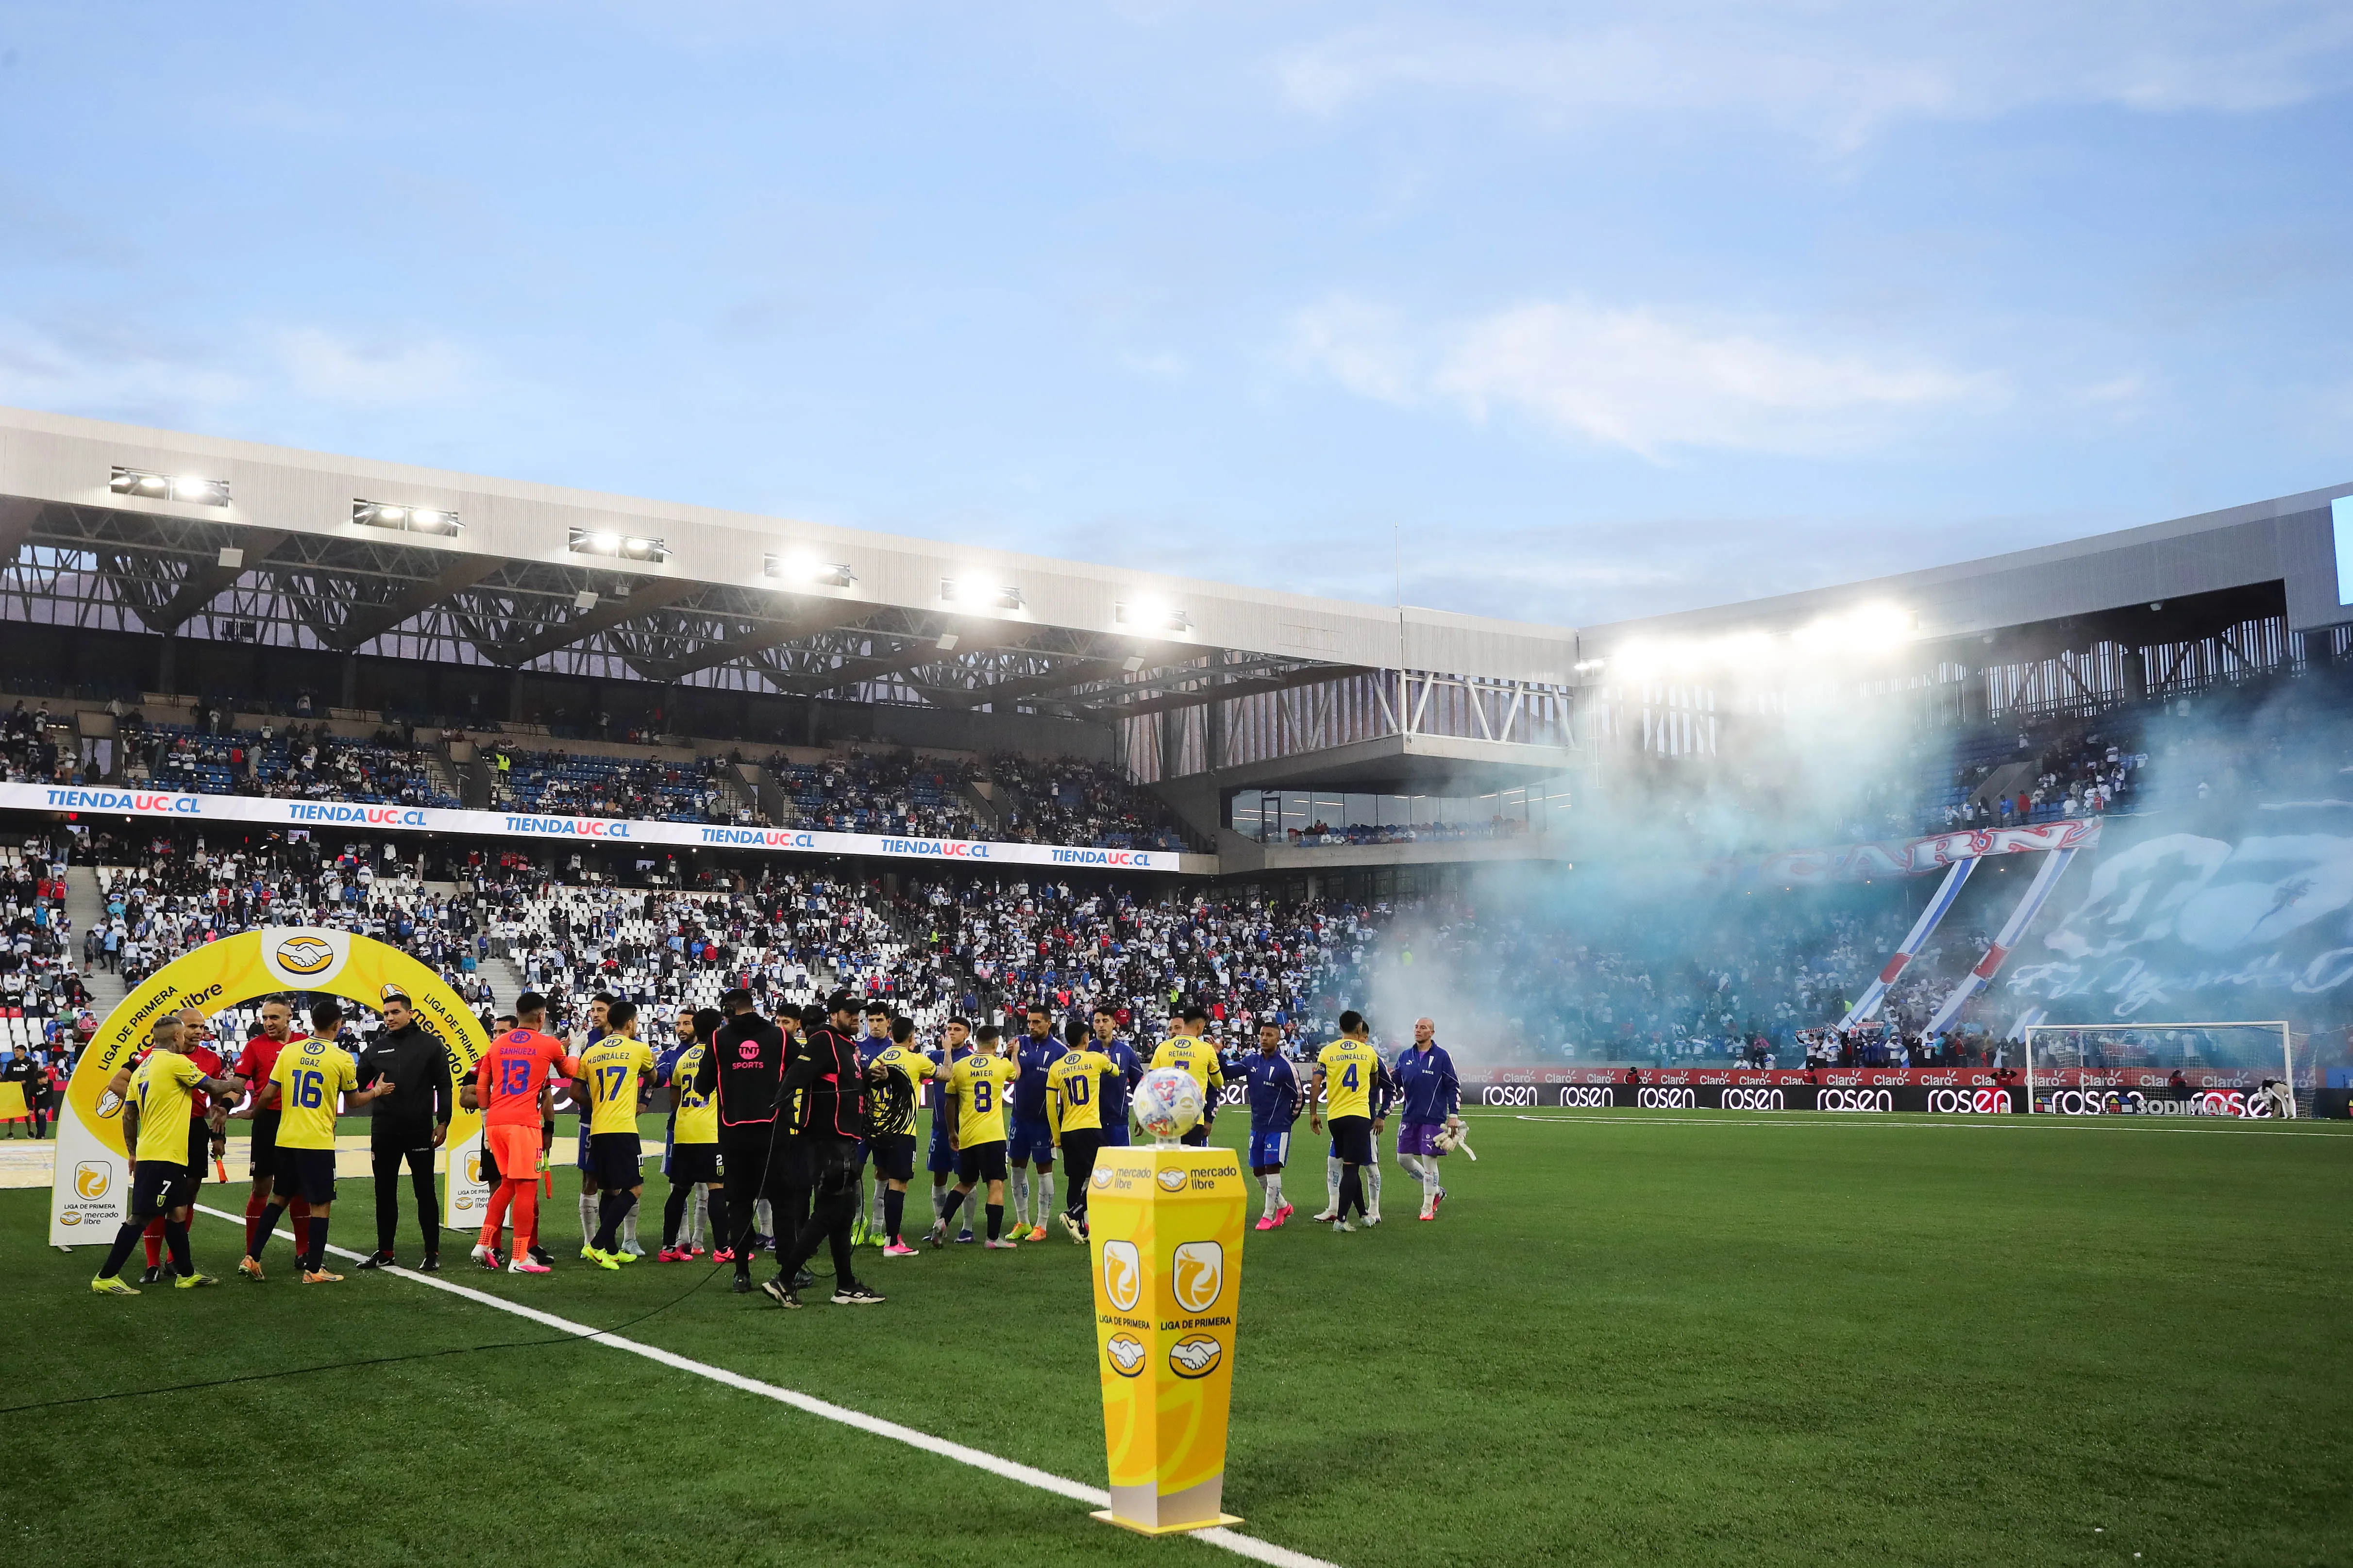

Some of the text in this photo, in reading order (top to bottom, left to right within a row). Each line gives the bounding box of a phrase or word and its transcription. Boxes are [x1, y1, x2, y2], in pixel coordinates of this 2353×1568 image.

[47, 790, 201, 813] TIENDAUC.CL
[289, 804, 426, 825] TIENDAUC.CL
[506, 817, 630, 837] TIENDAUC.CL
[702, 829, 814, 848] TIENDAUC.CL
[881, 839, 990, 858] TIENDAUC.CL
[1052, 849, 1150, 867] TIENDAUC.CL
[180, 984, 223, 1008] libre
[98, 1044, 121, 1071] LIGA
[116, 1025, 133, 1043] DE
[129, 985, 178, 1027] PRIMERA
[423, 993, 446, 1017] LIGA
[444, 1014, 458, 1030] DE
[454, 1028, 481, 1064] PRIME
[500, 1047, 537, 1055] SANHUEZA
[738, 1046, 760, 1055] TNT
[300, 1057, 320, 1067] OGAZ
[732, 1061, 764, 1070] SPORTS
[501, 1060, 531, 1095] 13
[1342, 1063, 1359, 1092] 4
[1461, 1070, 1491, 1083] Claro
[1503, 1071, 1533, 1083] Claro
[1545, 1071, 1574, 1083] Claro
[1587, 1071, 1613, 1084] Claro
[1661, 1072, 1687, 1084] Claro
[1699, 1073, 1728, 1085] Claro
[1739, 1073, 1769, 1085] Claro
[1781, 1075, 1805, 1085] Clar
[1826, 1072, 1860, 1085] Claro
[1873, 1072, 1907, 1085] Claro
[1920, 1072, 1955, 1085] Claro
[2139, 1074, 2169, 1086] Clar
[2202, 1073, 2247, 1087] Claro
[292, 1069, 324, 1109] 16
[596, 1066, 628, 1103] 17
[1064, 1075, 1089, 1106] 10
[974, 1081, 992, 1113] 8
[1483, 1086, 1537, 1106] rosen
[1560, 1086, 1613, 1107] rosen
[1638, 1087, 1695, 1109] rosen
[1722, 1088, 1783, 1110] rosen
[1817, 1089, 1892, 1112] rosen
[1928, 1089, 2012, 1114] rosen
[2136, 1100, 2235, 1116] SODIMAC
[1116, 1168, 1151, 1178] mercado
[1191, 1165, 1237, 1178] mercado
[161, 1180, 171, 1194] 7
[1114, 1177, 1131, 1189] libre
[1192, 1178, 1214, 1190] libre
[1099, 1314, 1151, 1330] LIGA DE PRIMERA
[1160, 1316, 1231, 1331] LIGA DE PRIMERA
